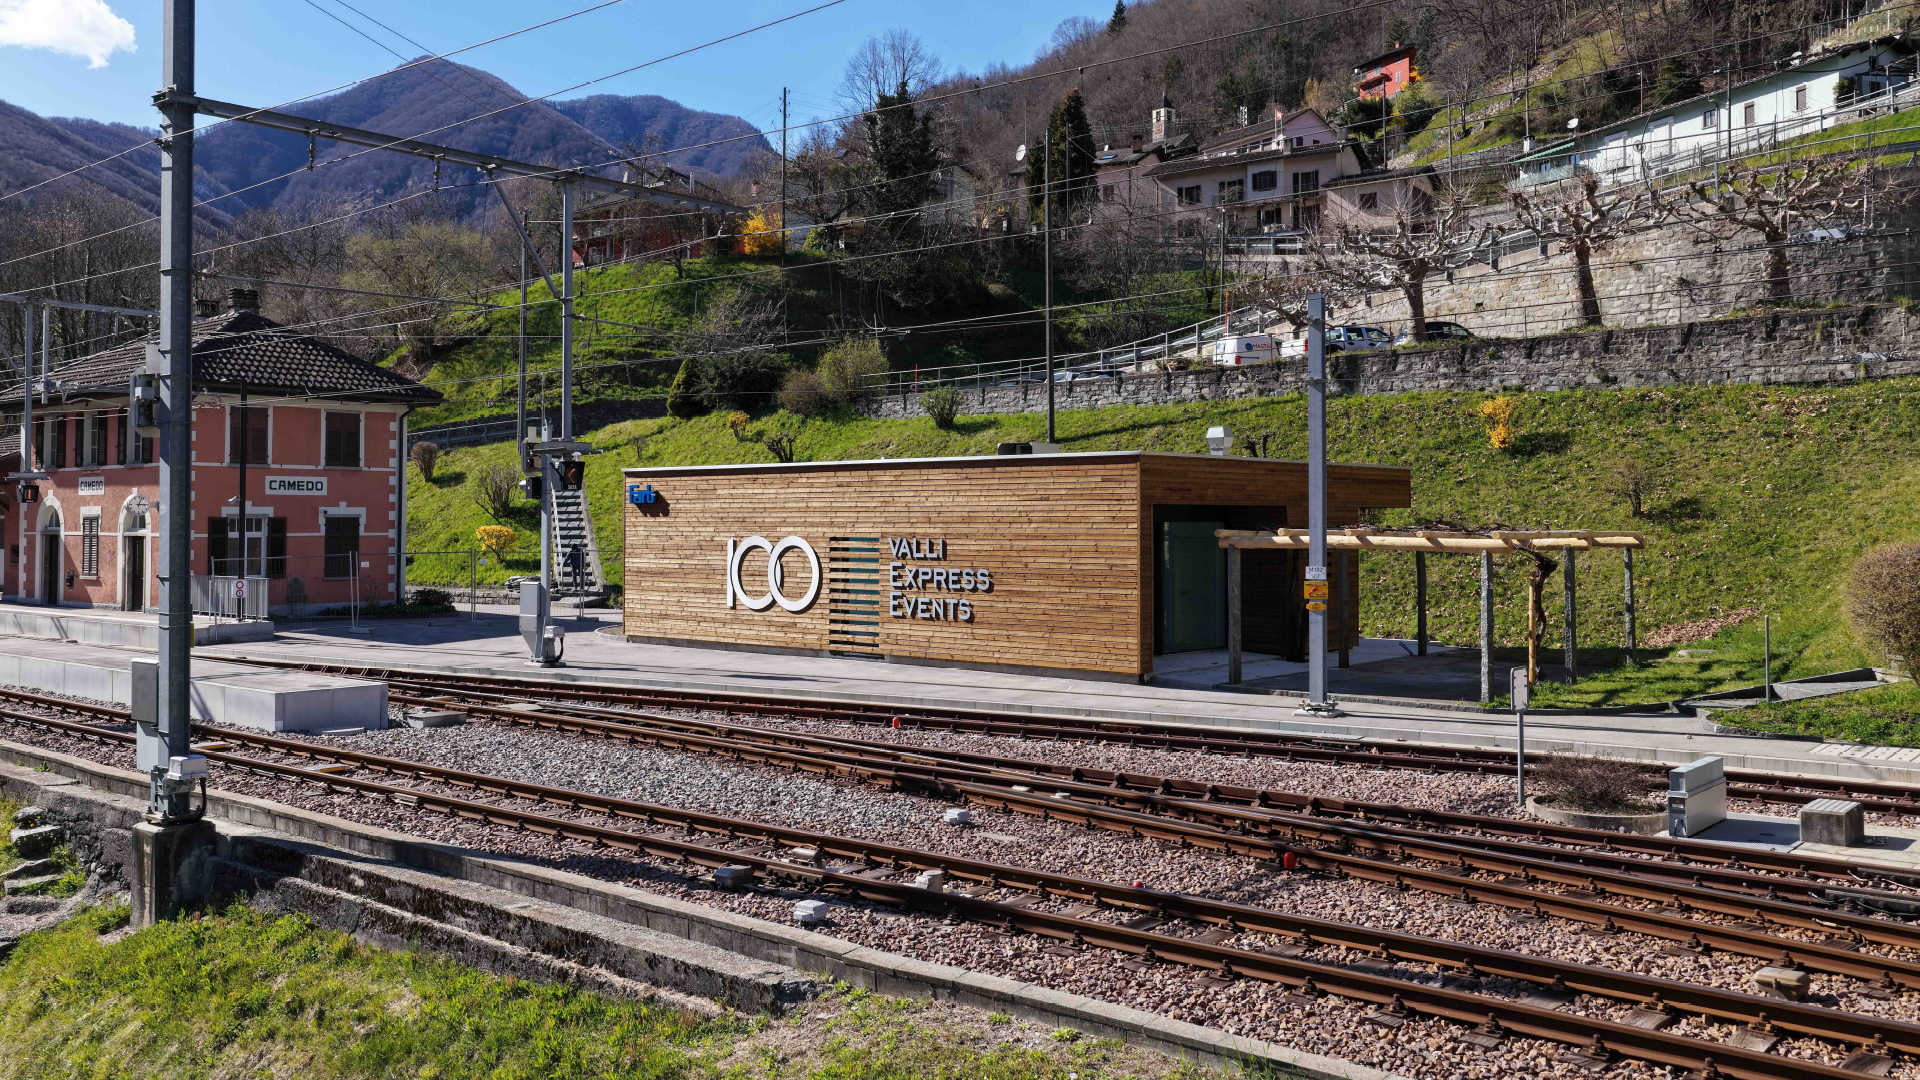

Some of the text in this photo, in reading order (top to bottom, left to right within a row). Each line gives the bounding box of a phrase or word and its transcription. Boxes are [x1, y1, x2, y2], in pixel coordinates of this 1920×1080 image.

[80, 480, 103, 492] CAMEDO
[269, 480, 324, 491] CAMEDO
[629, 484, 656, 504] Fart
[888, 537, 945, 559] VALLI
[727, 535, 820, 612] 100
[889, 561, 990, 591] EXPRESS
[889, 591, 972, 621] EVENTS
